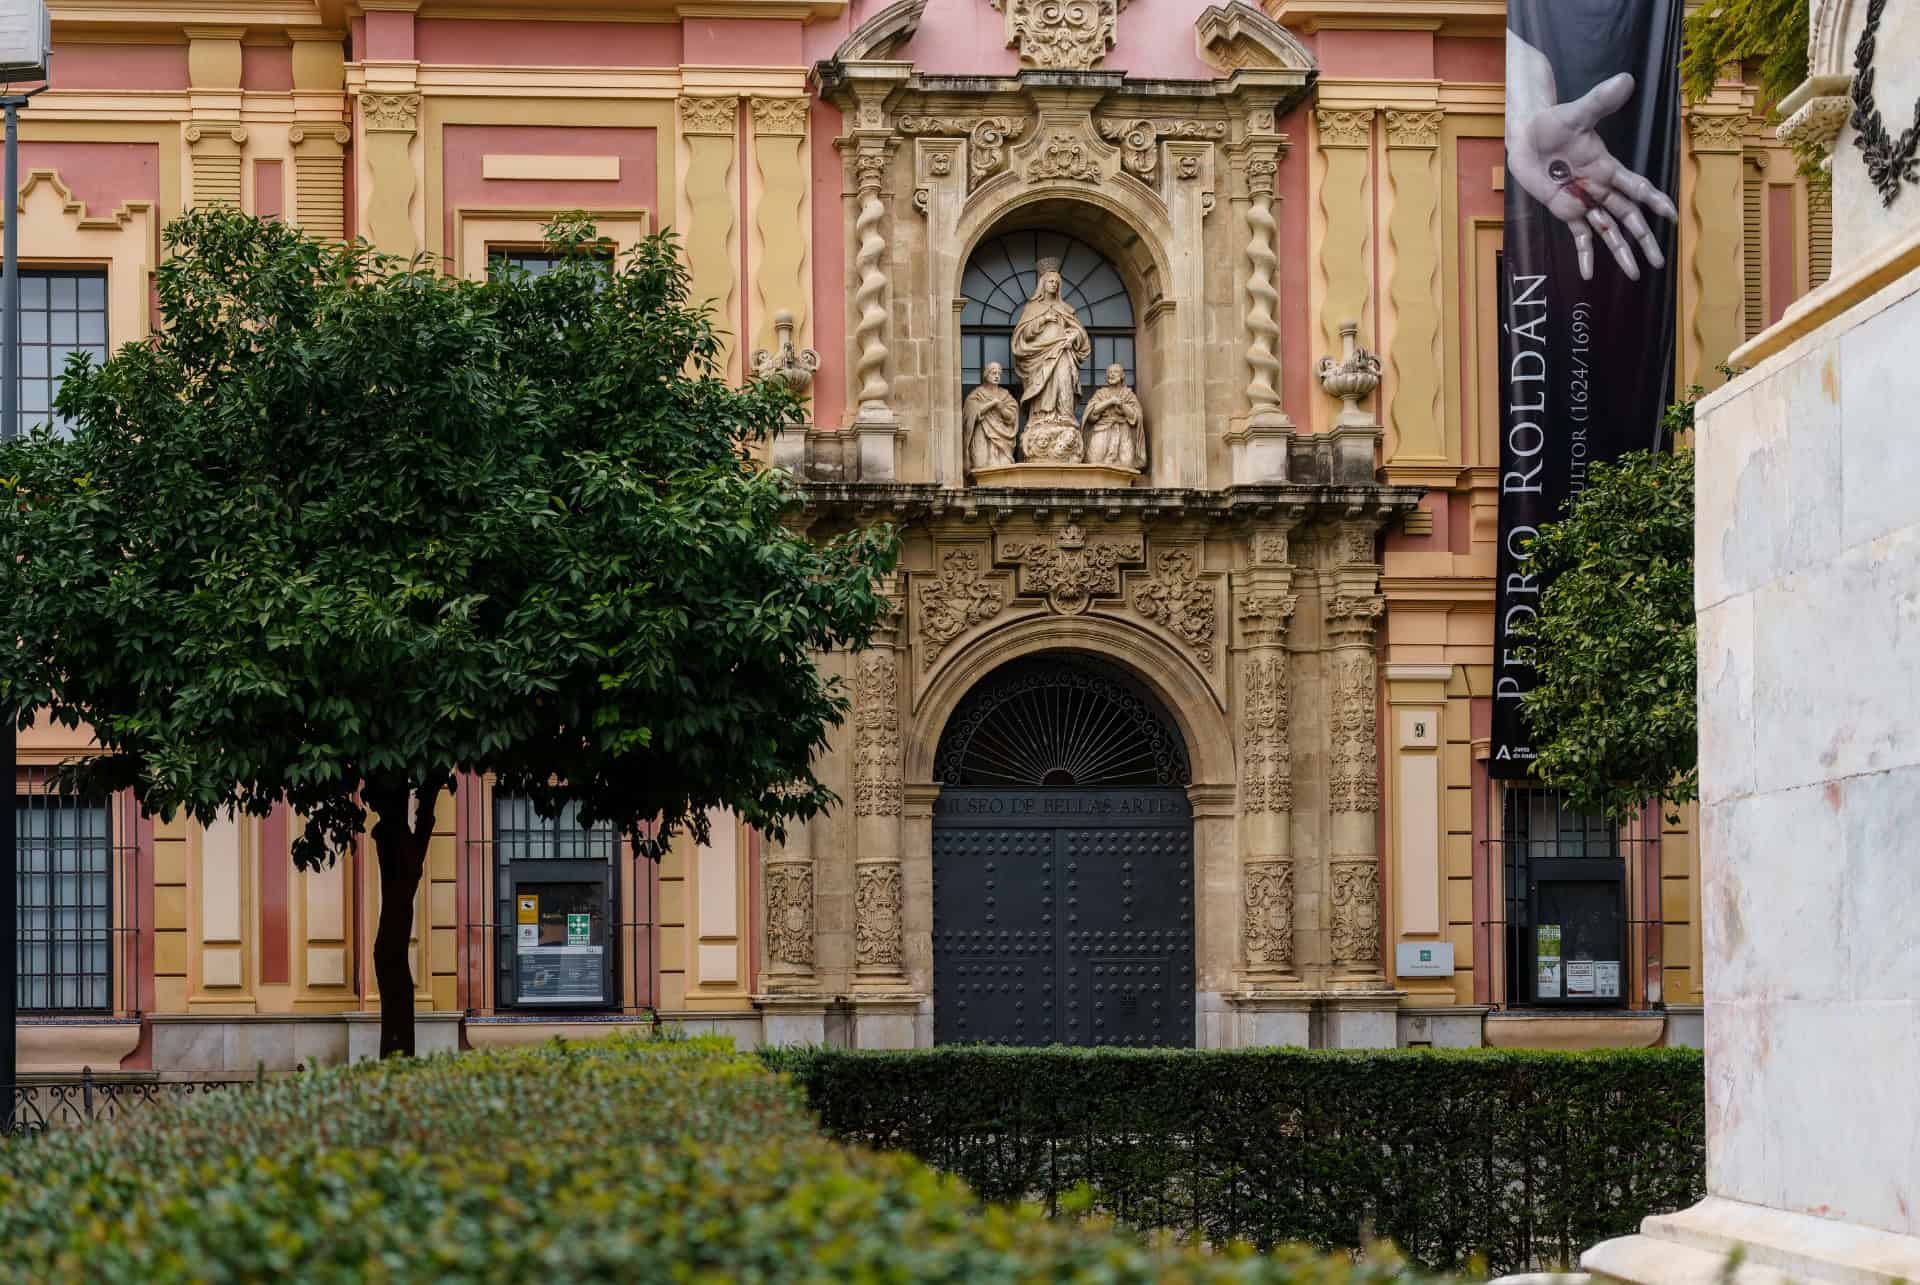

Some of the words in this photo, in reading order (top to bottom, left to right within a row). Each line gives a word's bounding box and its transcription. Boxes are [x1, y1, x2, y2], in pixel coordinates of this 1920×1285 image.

[1503, 274, 1547, 495] ROLDÁN
[1570, 302, 1592, 422] (1624/1699)
[1496, 525, 1541, 700] PEDRO
[1415, 722, 1424, 738] 9
[1009, 798, 1033, 815] DE
[1043, 798, 1112, 815] BELLAS
